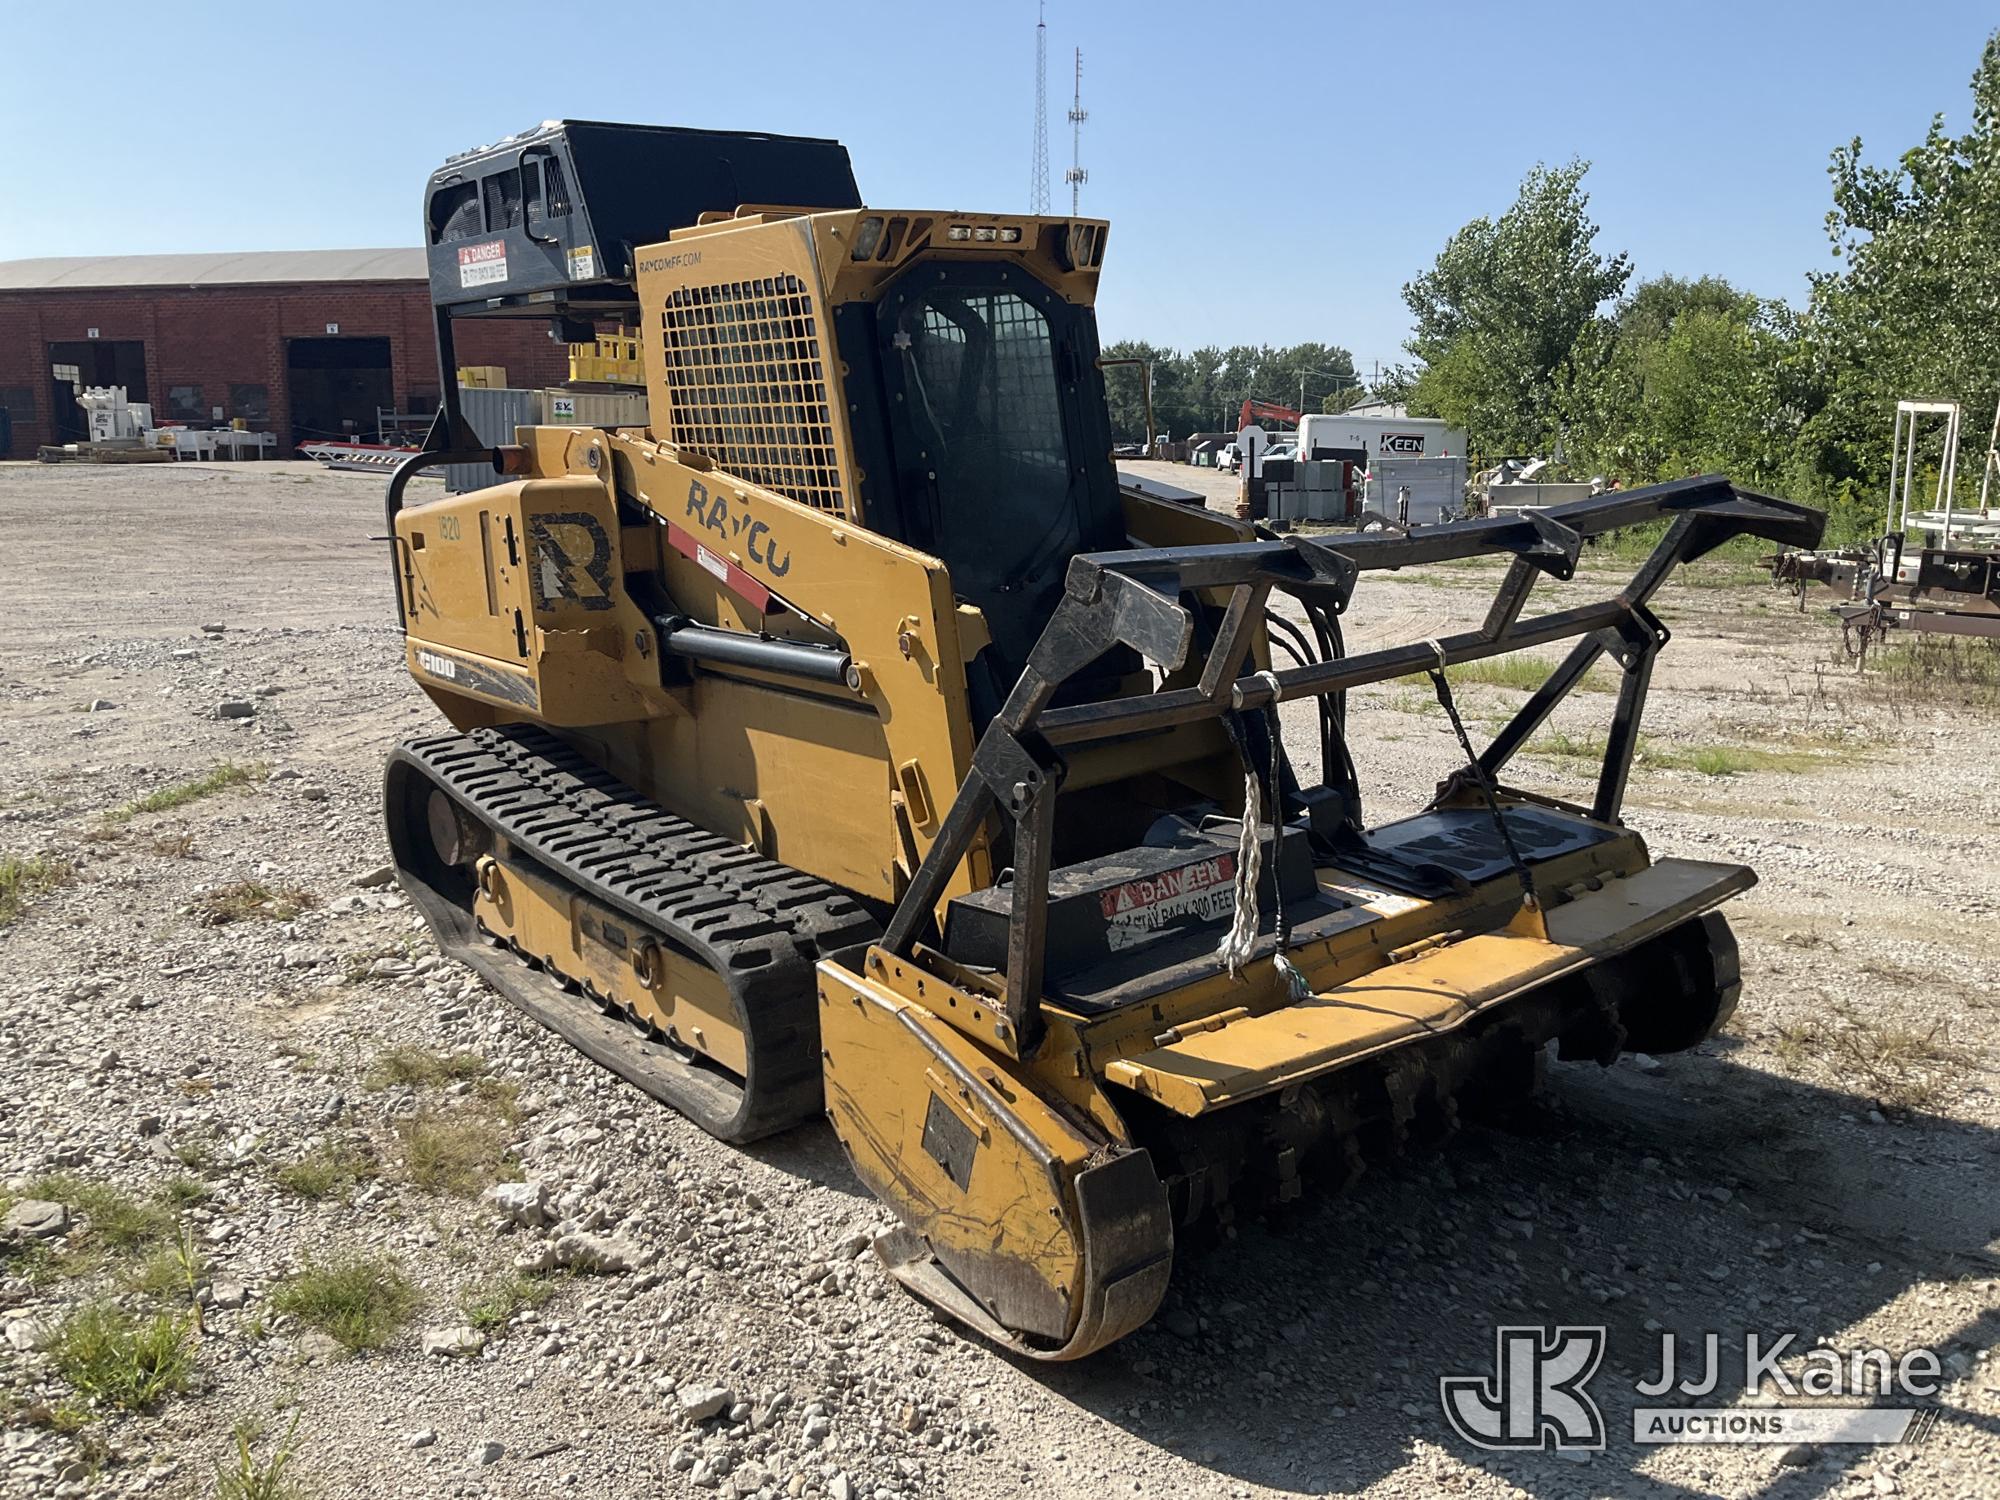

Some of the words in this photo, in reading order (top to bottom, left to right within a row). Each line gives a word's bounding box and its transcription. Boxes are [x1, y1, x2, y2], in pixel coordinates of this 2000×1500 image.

[471, 243, 501, 263] DANGER
[1381, 434, 1424, 454] KEEN
[1191, 895, 1212, 919] 300
